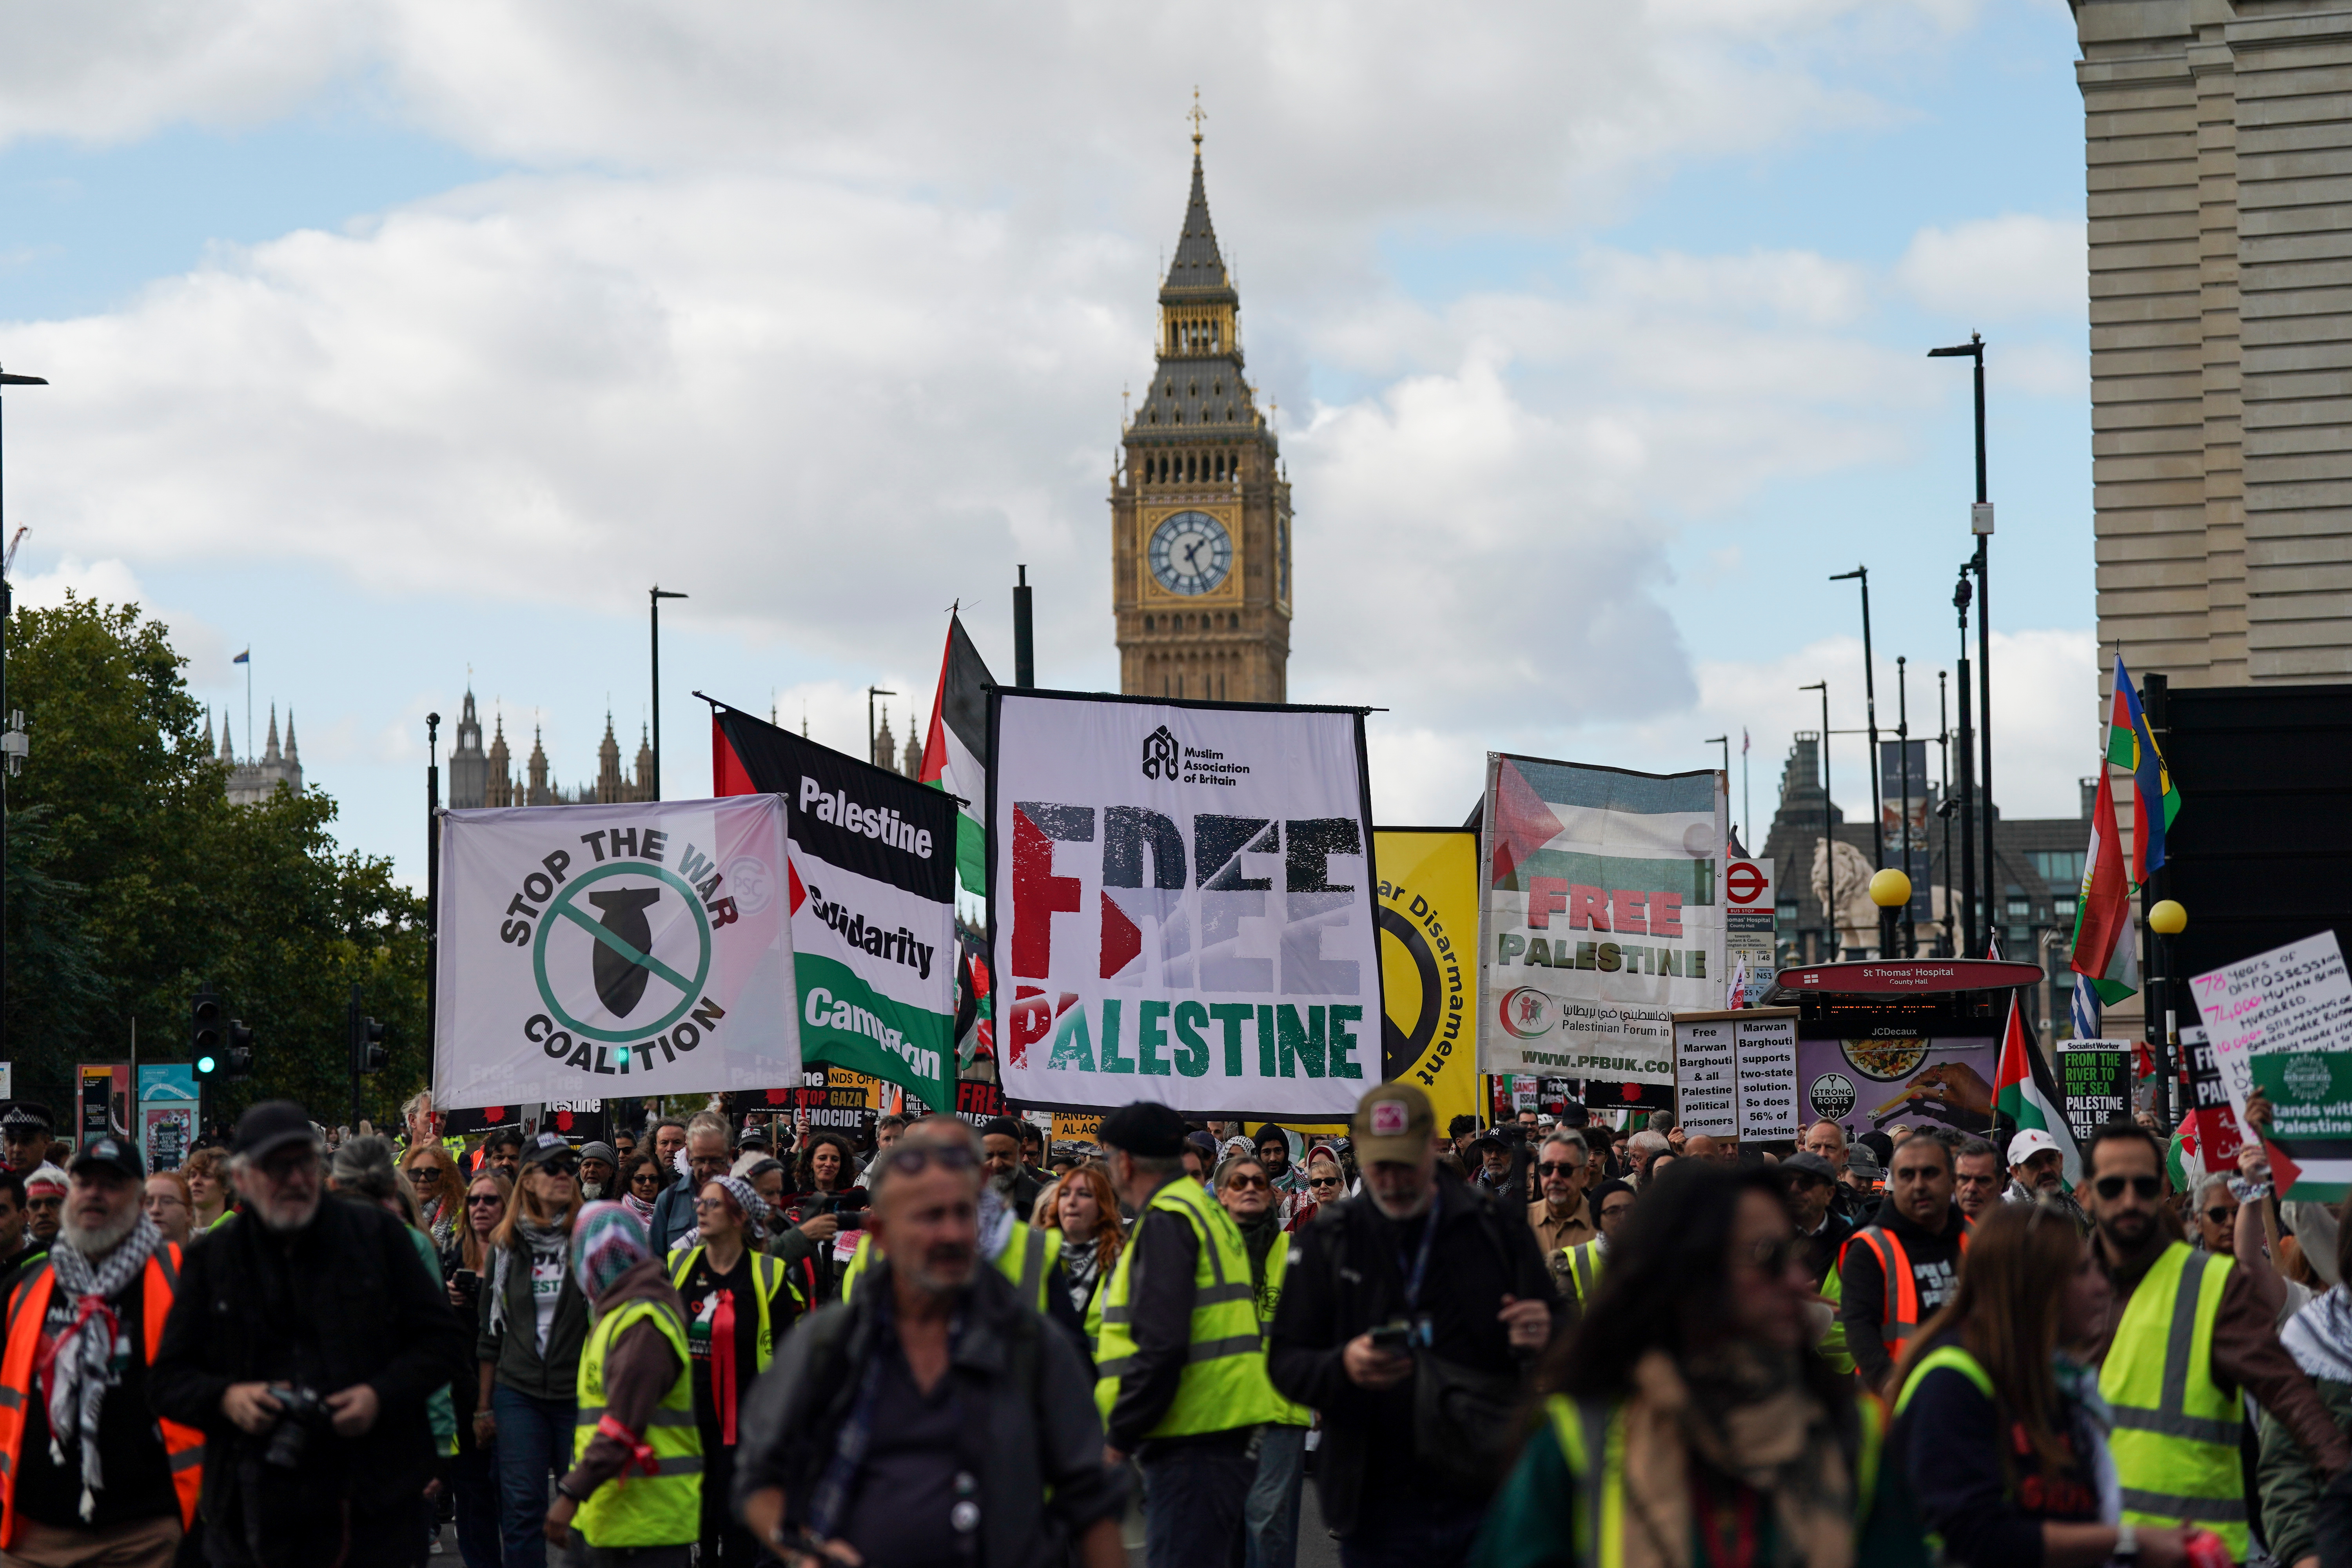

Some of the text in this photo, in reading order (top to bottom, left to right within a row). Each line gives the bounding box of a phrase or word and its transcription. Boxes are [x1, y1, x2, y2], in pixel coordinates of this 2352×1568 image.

[1184, 747, 1223, 760] Muslim
[1183, 760, 1250, 773] Association
[1183, 773, 1236, 786] of Britain
[799, 775, 932, 858] Palestine
[501, 828, 738, 947] STOP THE WAR
[1012, 801, 1363, 996] FREE
[1528, 877, 1683, 939] FREE
[1498, 934, 1707, 979] PALESTINE
[1863, 968, 1954, 977] St Thomas' Hospital
[1408, 894, 1463, 1087] Disarmament
[2195, 973, 2226, 997] 78
[1009, 985, 1363, 1079] PALESTINE
[1563, 1020, 1669, 1037] Palestinian Forum in
[1693, 1028, 1717, 1037] Free
[1743, 1023, 1787, 1032] Marwan
[1871, 1027, 1917, 1036] JCDecaux
[524, 996, 726, 1074] COALITION
[1684, 1044, 1727, 1053] Marwan
[1739, 1036, 1793, 1048] Barghouti
[1521, 1051, 1674, 1074] WWW.PFBUK.CO
[1679, 1056, 1733, 1068] Barghouti
[1742, 1053, 1791, 1064] supports
[2065, 1053, 2121, 1067] FROM THE
[857, 1074, 877, 1085] OFF
[1694, 1072, 1719, 1081] & all
[1740, 1068, 1793, 1078] two-state
[2065, 1067, 2115, 1081] RIVER TO
[1682, 1086, 1733, 1096] Palestine
[1744, 1082, 1791, 1093] solution.
[2065, 1082, 2111, 1096] THE SEA
[795, 1090, 827, 1105] STOP
[830, 1091, 862, 1107] GAZA
[1746, 1098, 1790, 1107] So does
[2066, 1096, 2123, 1111] PALESTINE
[906, 1102, 921, 1110] WILL
[1686, 1100, 1730, 1113] political
[793, 1108, 862, 1128] GENOCIDE
[1749, 1111, 1788, 1121] 56% of
[2067, 1111, 2110, 1125] WILL BE
[1682, 1118, 1733, 1129] prisoners
[2273, 1117, 2352, 1133] Palestine
[1743, 1126, 1795, 1136] Palestine
[2073, 1125, 2093, 1139] REE
